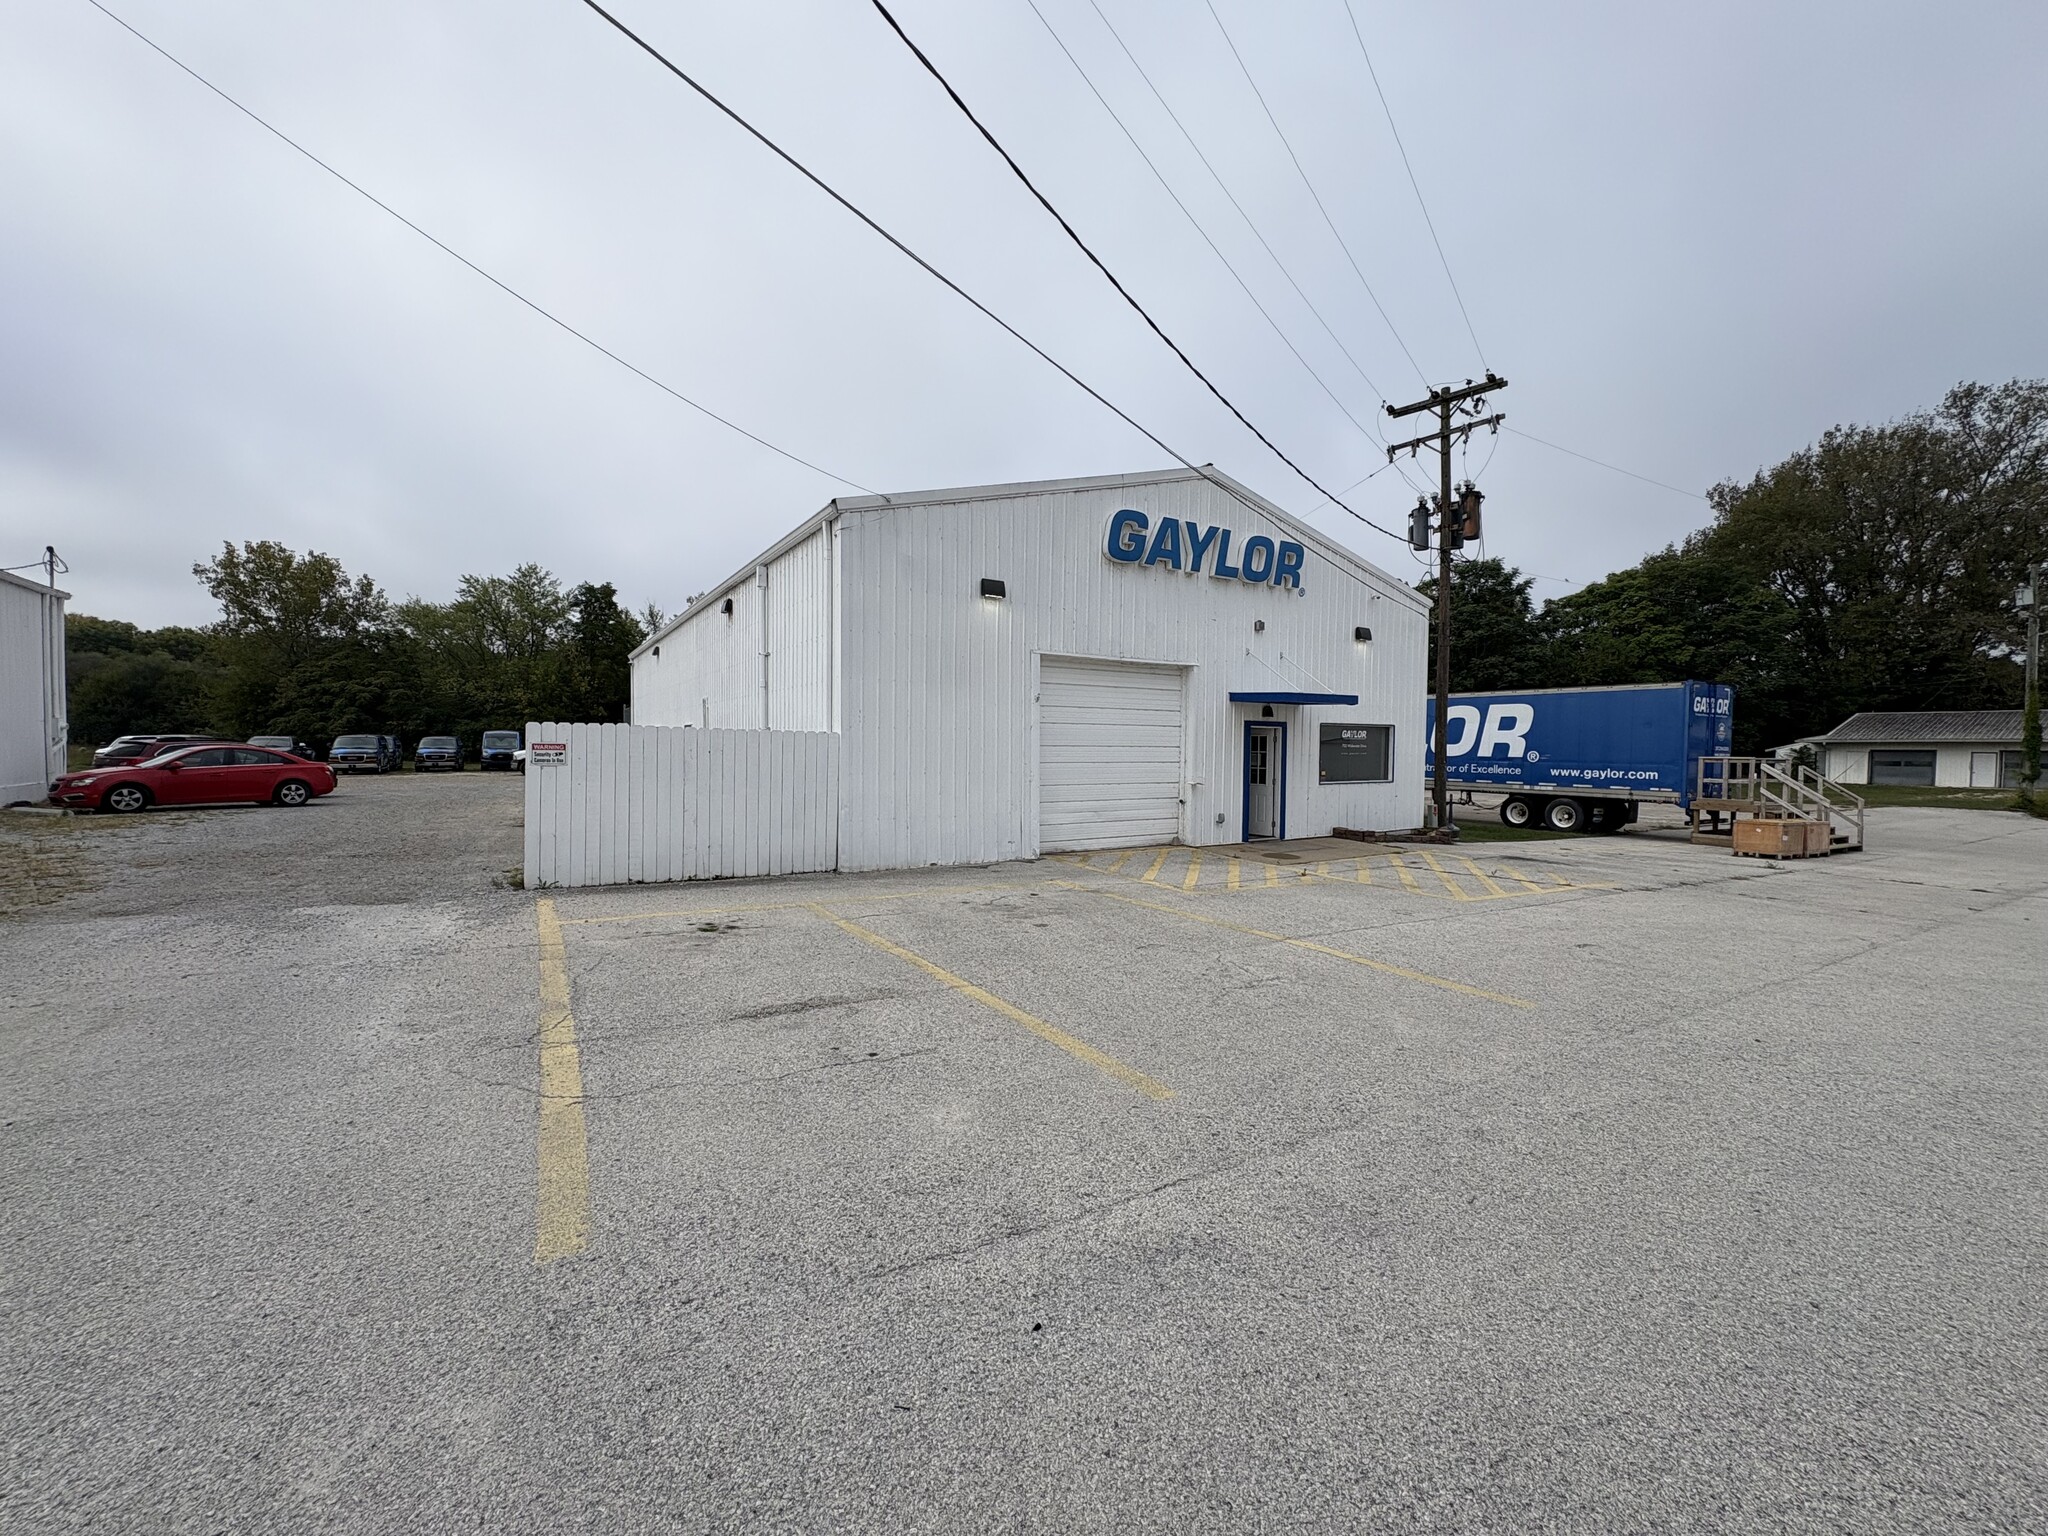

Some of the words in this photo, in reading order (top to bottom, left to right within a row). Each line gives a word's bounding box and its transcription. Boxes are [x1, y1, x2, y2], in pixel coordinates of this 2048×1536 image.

[1105, 508, 1305, 589] GAYLOR
[1426, 703, 1534, 758] OR
[1458, 763, 1469, 773] of
[1470, 763, 1522, 775] Excellence
[1550, 768, 1659, 780] www.gaylor.com
